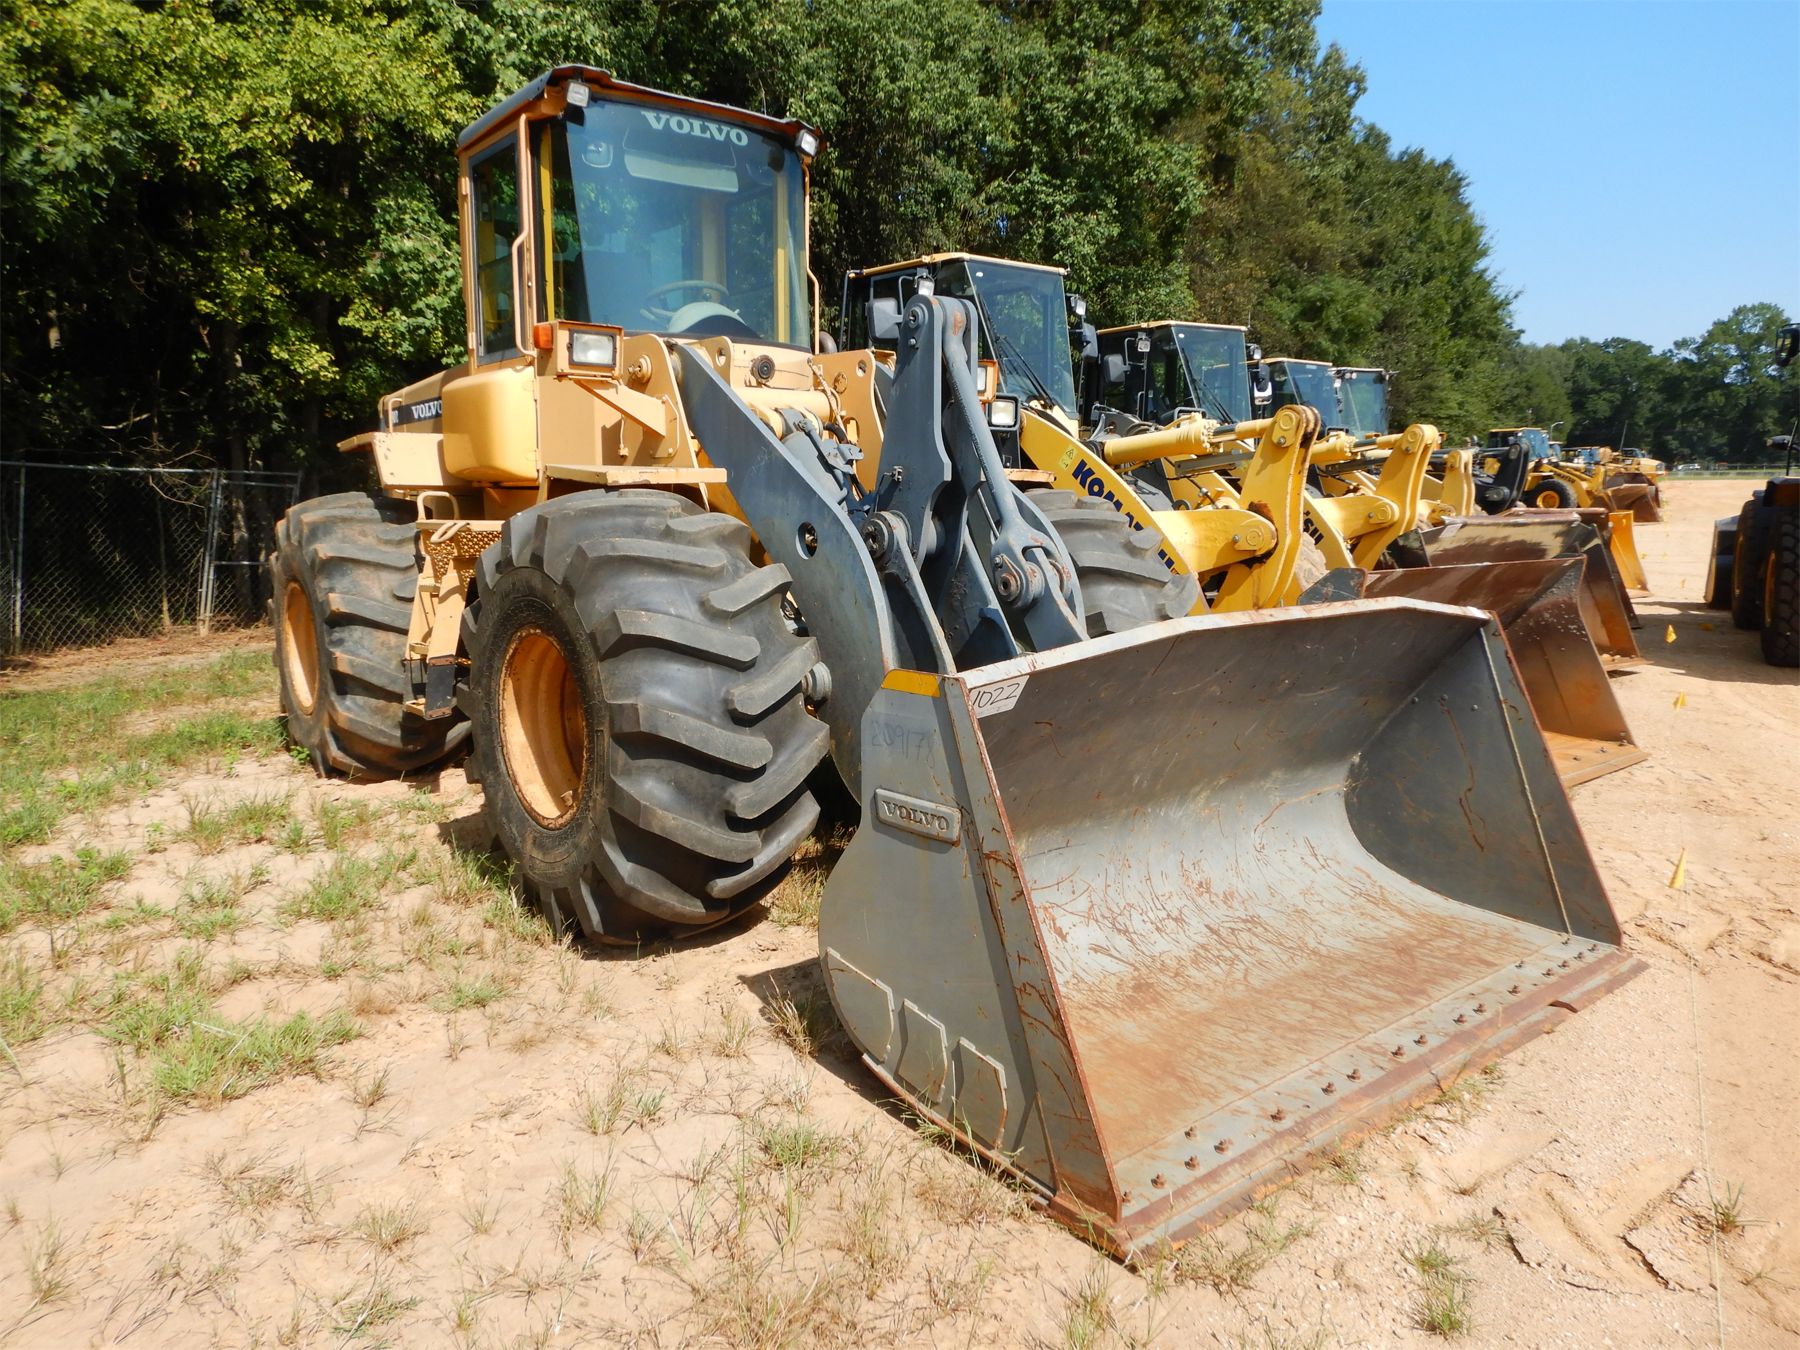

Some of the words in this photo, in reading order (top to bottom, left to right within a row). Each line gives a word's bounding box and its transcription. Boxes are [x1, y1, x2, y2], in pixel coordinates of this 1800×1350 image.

[641, 111, 749, 146] VOLVO
[973, 682, 1020, 708] 1022
[882, 800, 950, 831] VOLVO
